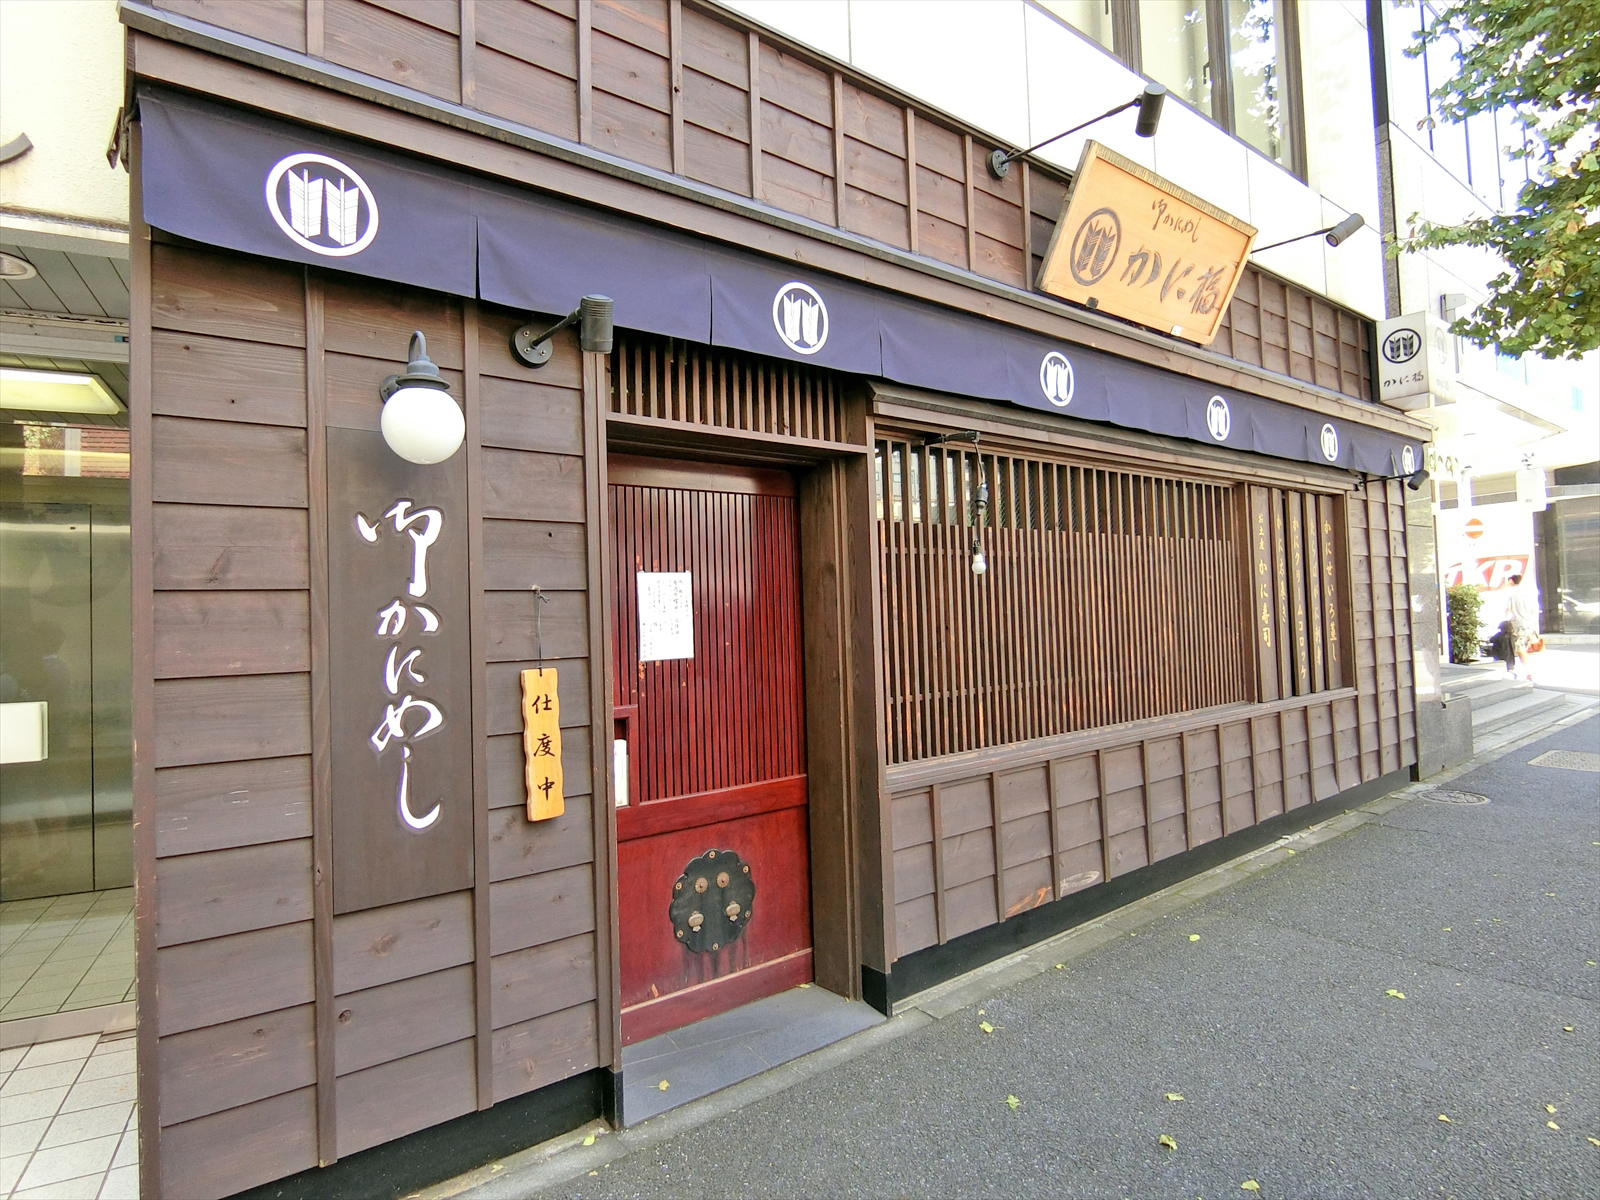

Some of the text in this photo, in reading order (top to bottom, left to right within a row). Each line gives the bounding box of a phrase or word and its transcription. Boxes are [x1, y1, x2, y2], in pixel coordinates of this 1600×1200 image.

[1120, 245, 1228, 315] かに福
[1291, 516, 1307, 680] かにクリームコロッケ
[1323, 519, 1338, 662] かにせいろ蒸し
[356, 500, 443, 830] 御かにめし
[532, 694, 556, 801] 仕度中
